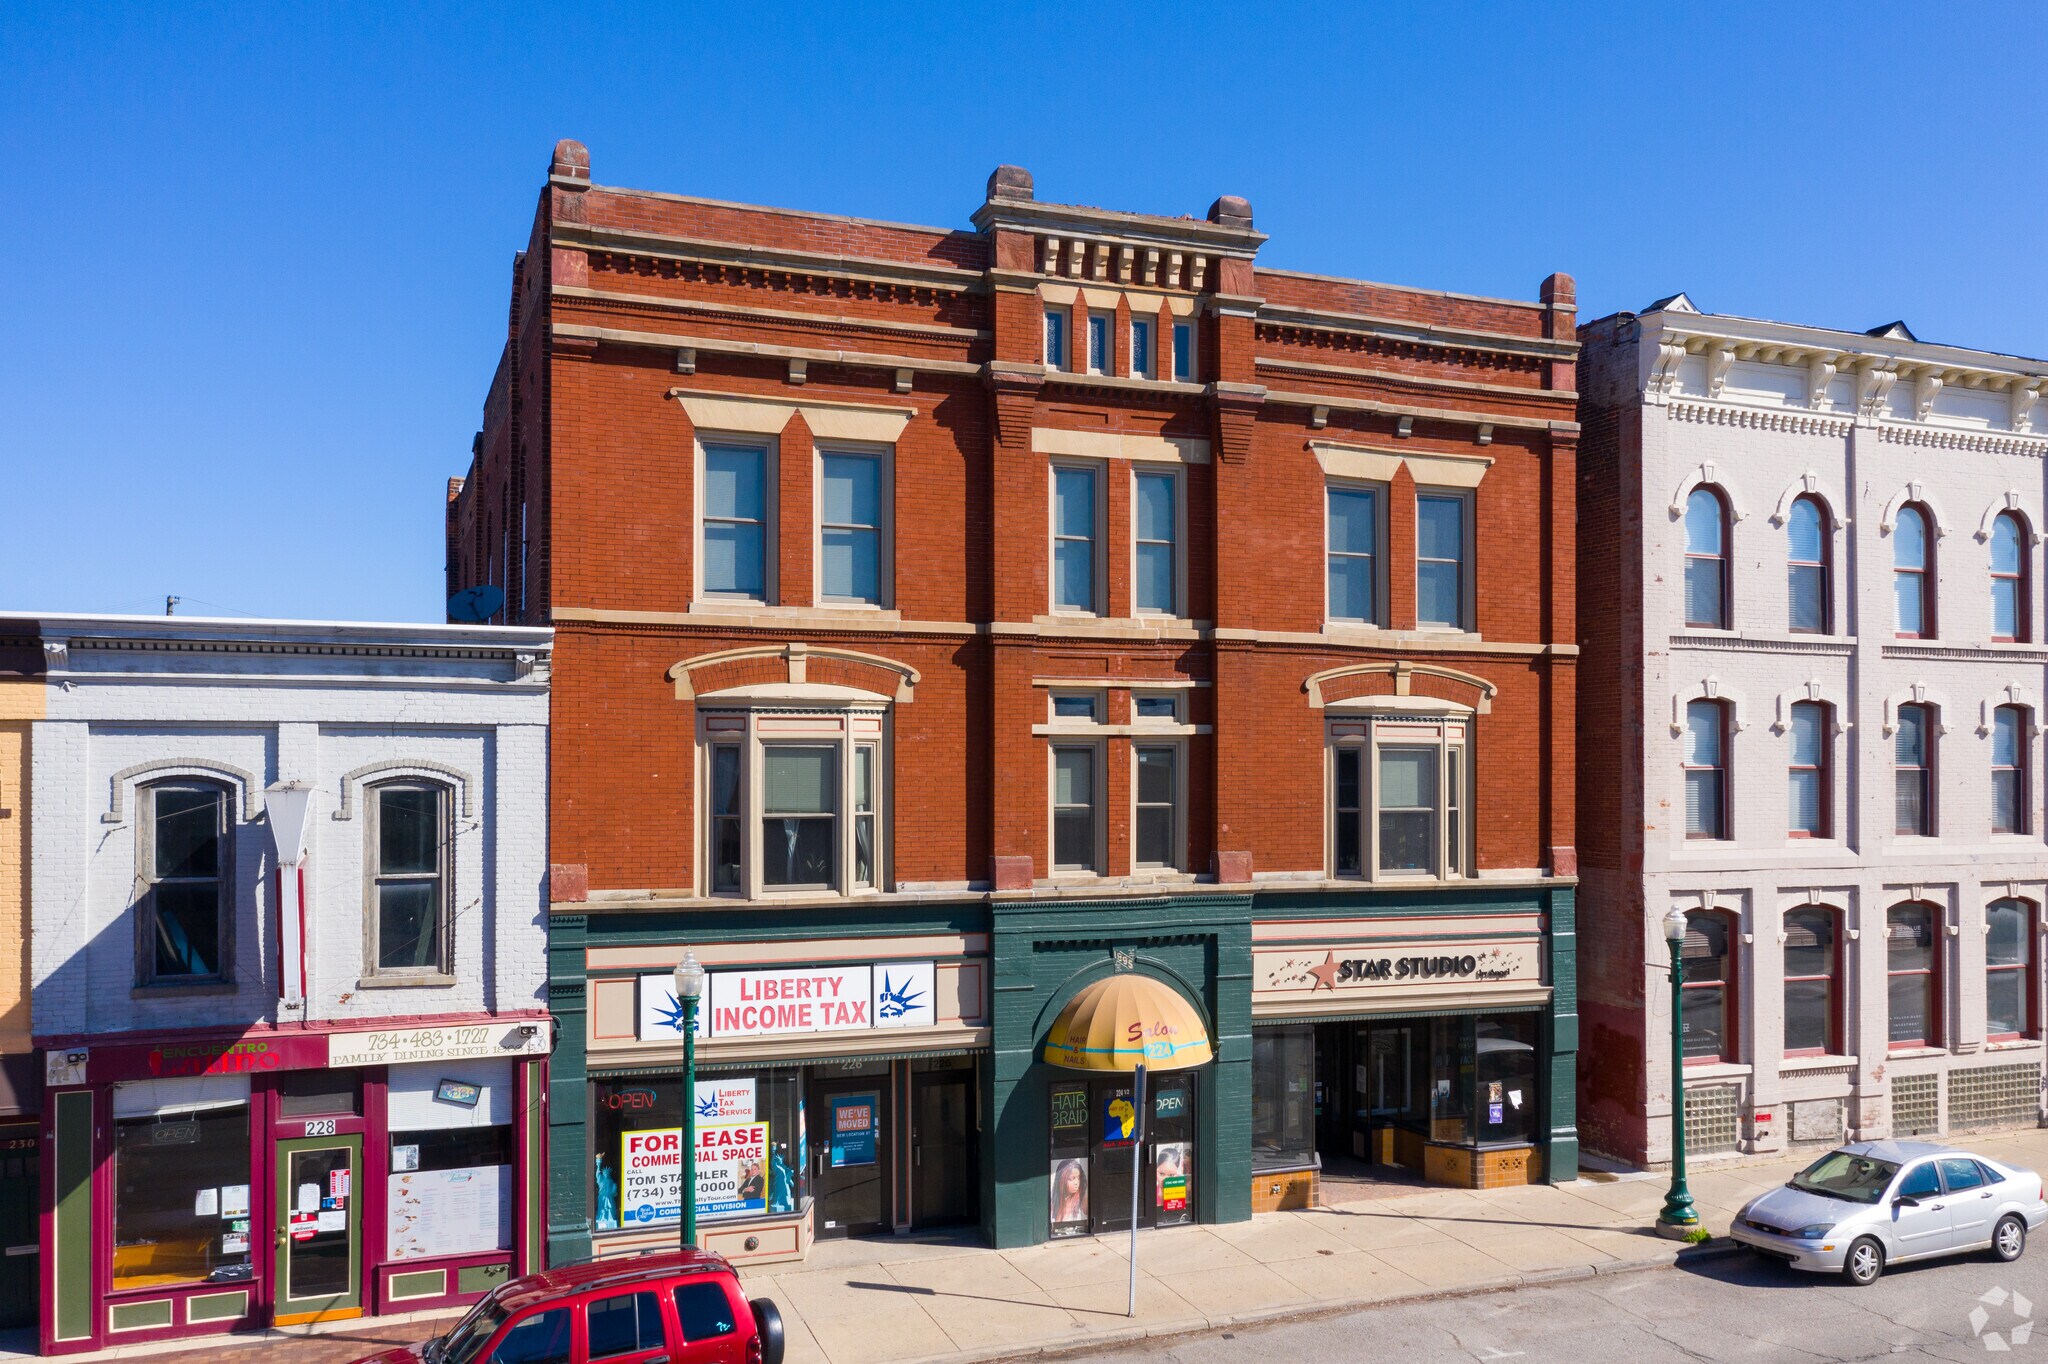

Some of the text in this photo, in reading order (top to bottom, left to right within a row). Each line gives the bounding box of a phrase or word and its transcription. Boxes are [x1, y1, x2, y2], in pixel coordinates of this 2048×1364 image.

[1340, 955, 1477, 978] STAR STUDIO
[740, 976, 843, 1001] LIBERTY
[715, 1000, 867, 1031] INCOME TAX
[1127, 1022, 1179, 1042] Salon
[1069, 1035, 1086, 1044] HAIR
[163, 1042, 268, 1058] ENCUENTRO
[332, 1052, 387, 1065] FAMILY
[394, 1048, 445, 1060] DINING
[447, 1046, 488, 1057] SINCE
[1149, 1044, 1171, 1057] 224
[841, 1060, 863, 1070] 226
[933, 1059, 952, 1068] 226
[1064, 1055, 1085, 1065] NAILS
[718, 1088, 750, 1098] LIBERTY
[608, 1093, 653, 1109] OPEN
[718, 1098, 735, 1107] TAX
[1052, 1094, 1087, 1110] HAIR
[1156, 1097, 1184, 1110] OPEN
[718, 1107, 752, 1116] SERVICE
[839, 1107, 868, 1119] WE'VE
[306, 1119, 335, 1136] 228
[838, 1118, 869, 1130] MOVED
[155, 1127, 196, 1141] OPEN
[9, 1139, 35, 1150] 230
[630, 1134, 679, 1154] FOR
[631, 1146, 762, 1168] COMMEIAL SPACE
[627, 1169, 728, 1187] TOM STAHLER
[627, 1181, 736, 1202] (734) 9-0000
[655, 1193, 737, 1207] www.ThltyTour.com
[659, 1201, 747, 1216] COMMIAL DIVISION
